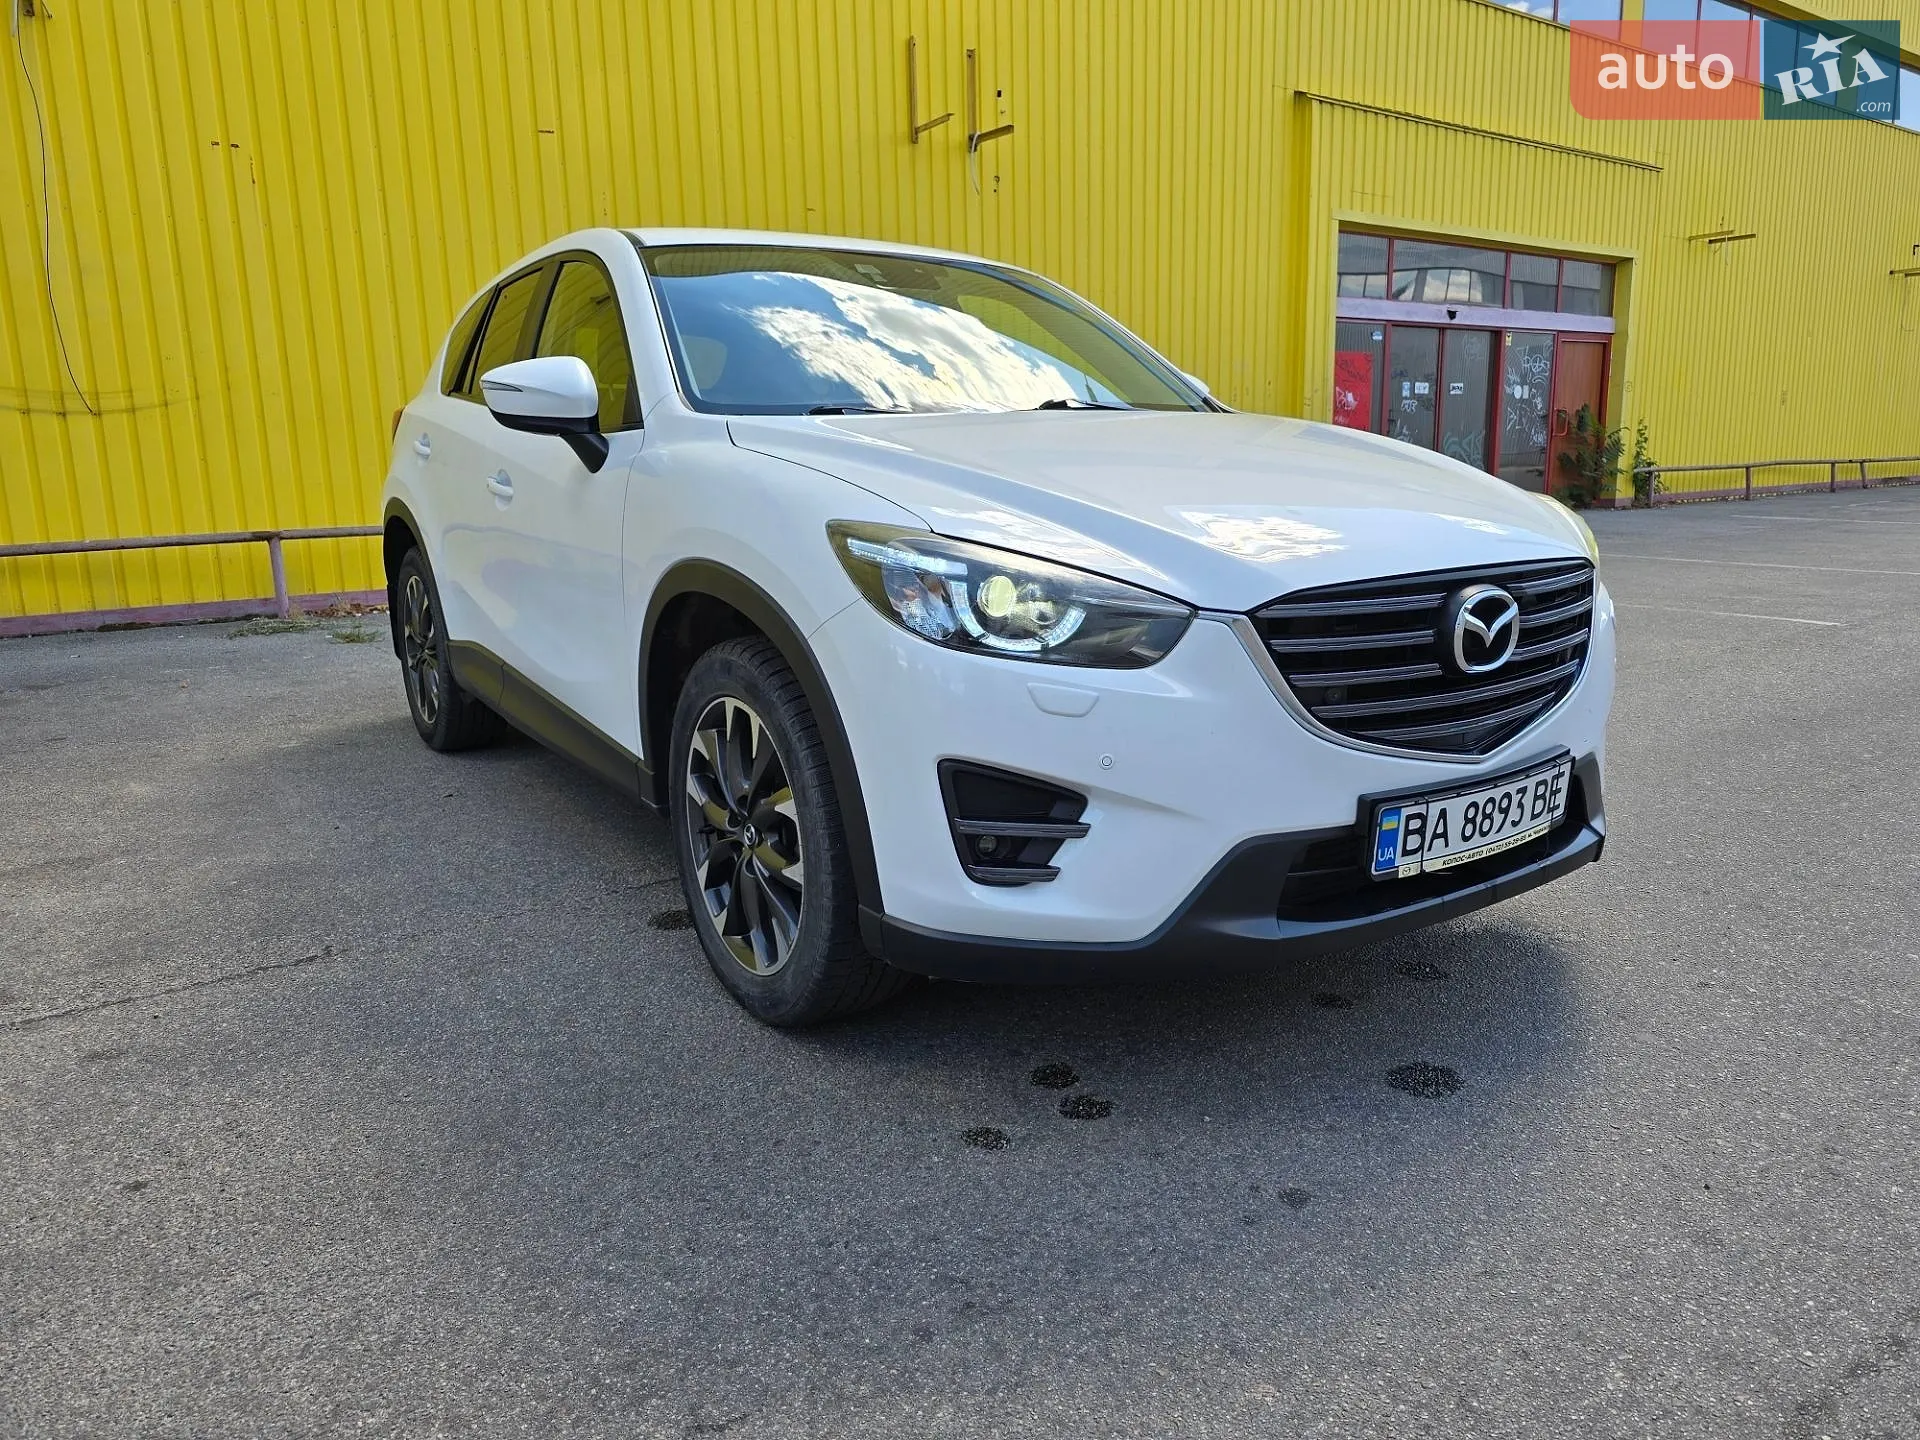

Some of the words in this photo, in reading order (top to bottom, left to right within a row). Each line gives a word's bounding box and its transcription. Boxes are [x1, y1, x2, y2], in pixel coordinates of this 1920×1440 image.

[1401, 807, 1450, 858] BA
[1461, 785, 1528, 842] 8893
[1530, 771, 1566, 821] BE
[1378, 846, 1395, 862] UA
